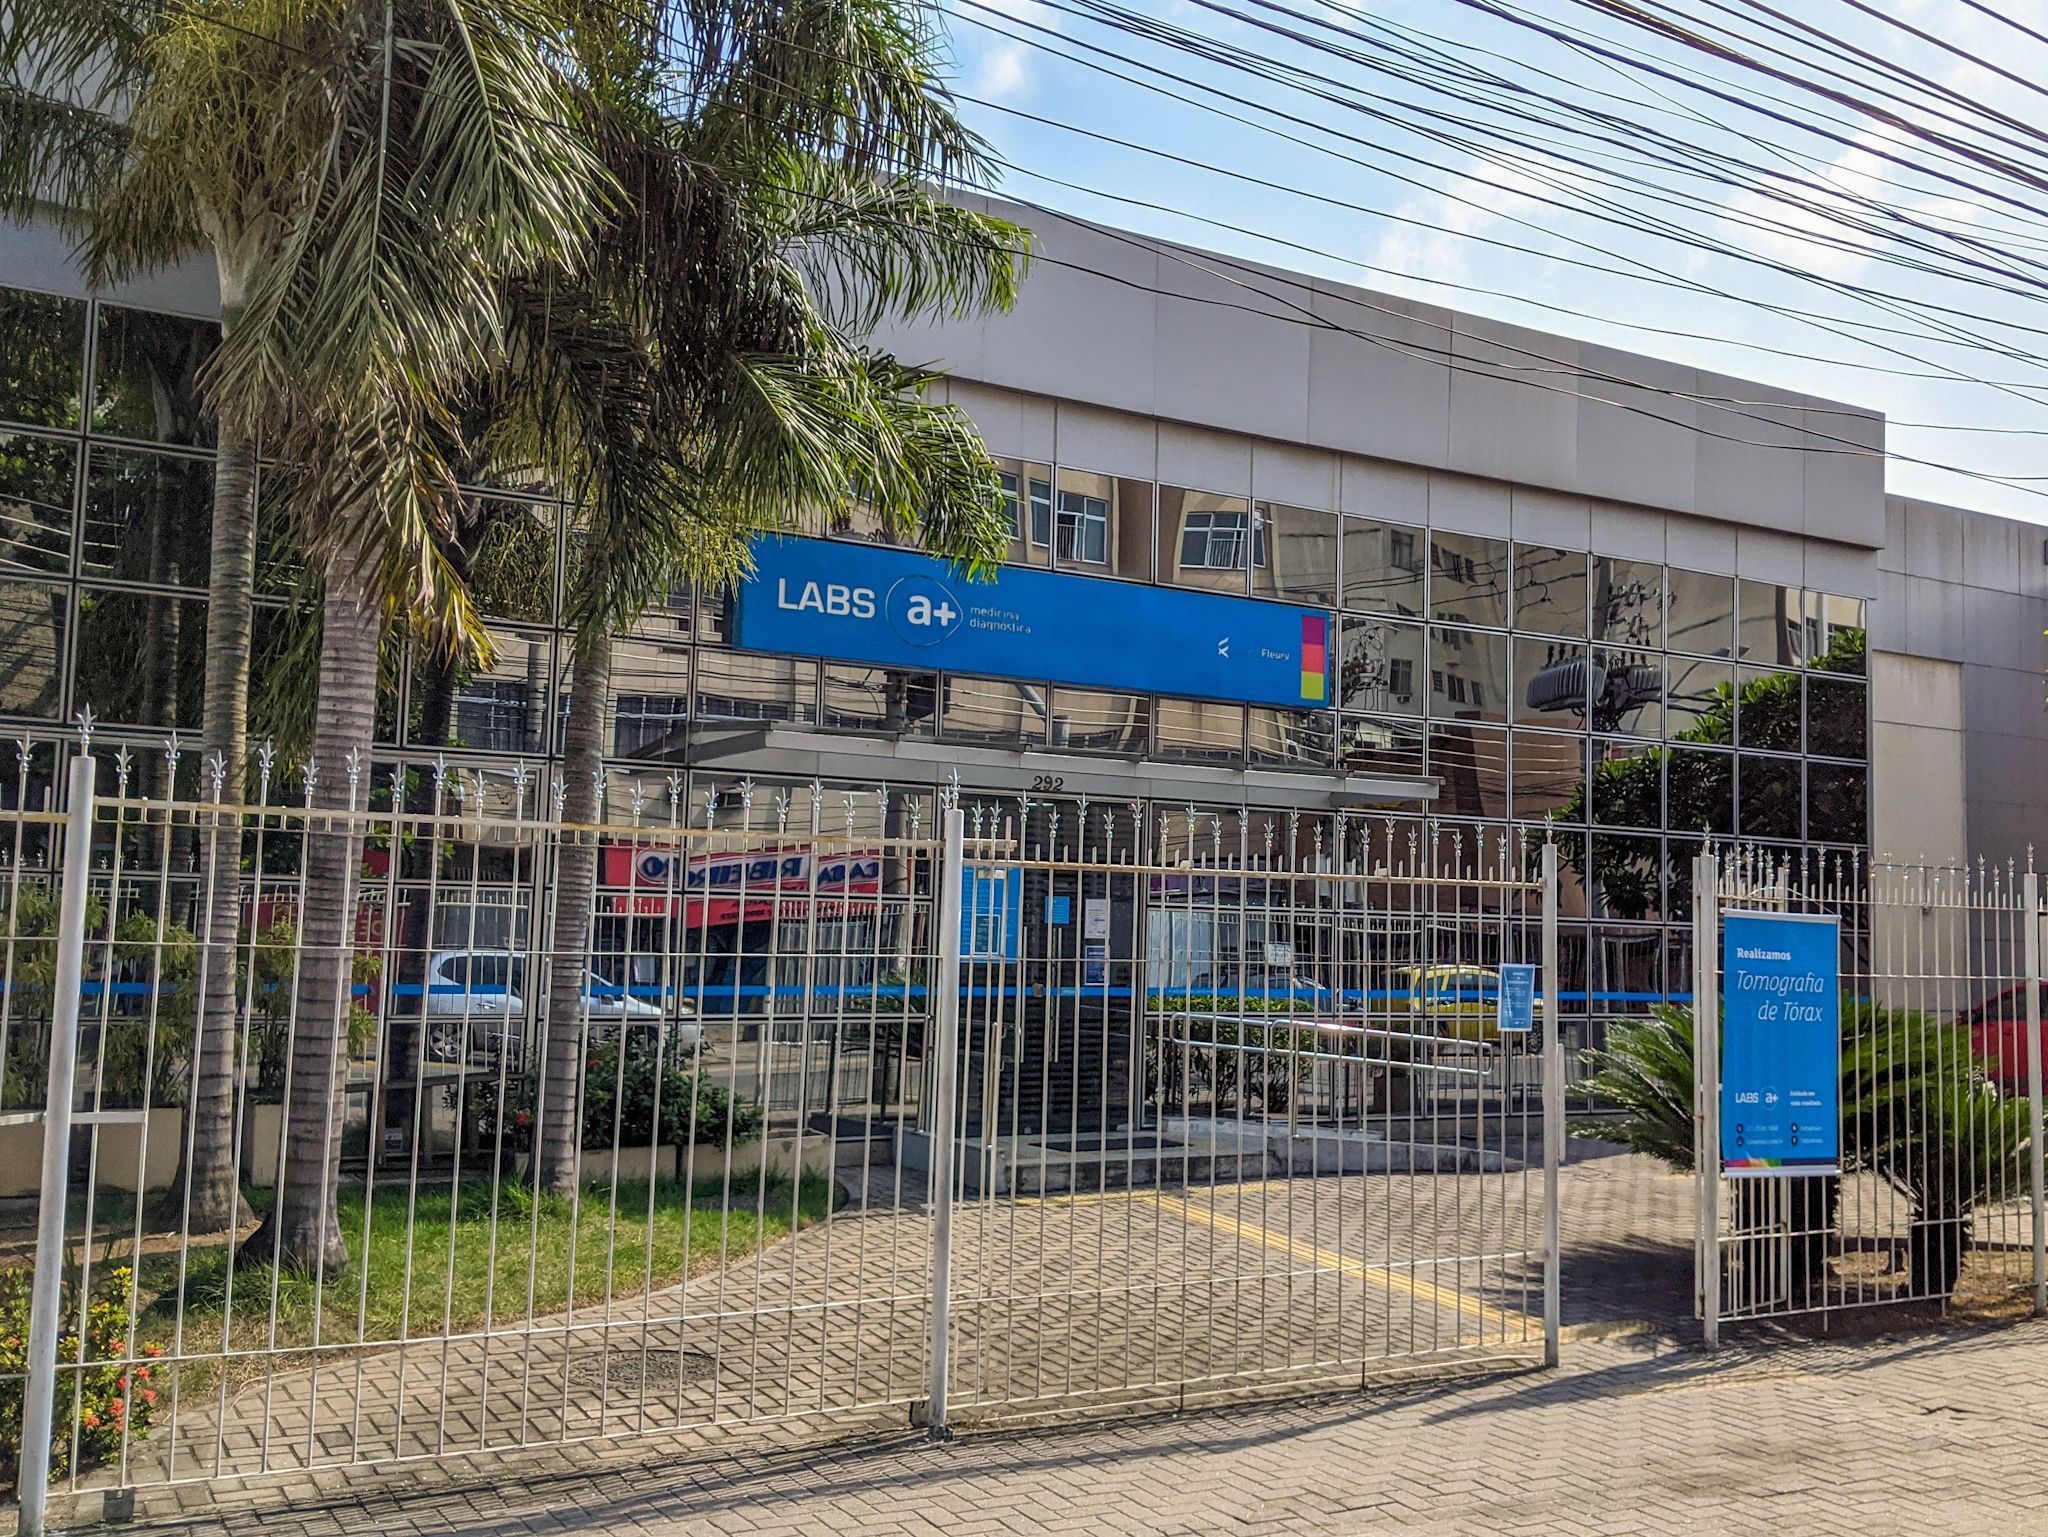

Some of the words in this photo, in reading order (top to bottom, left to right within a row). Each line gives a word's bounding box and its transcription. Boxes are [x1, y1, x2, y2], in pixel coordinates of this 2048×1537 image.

[778, 577, 876, 619] LABS
[907, 595, 956, 627] a+
[970, 607, 1019, 621] medicina
[1261, 648, 1290, 661] Fleury
[1033, 775, 1064, 792] 292
[1737, 948, 1791, 961] Realizamos
[1737, 970, 1825, 997] Tomografia
[1758, 1000, 1777, 1021] de
[1783, 1001, 1823, 1022] Tórax
[1735, 1092, 1759, 1104] LABS
